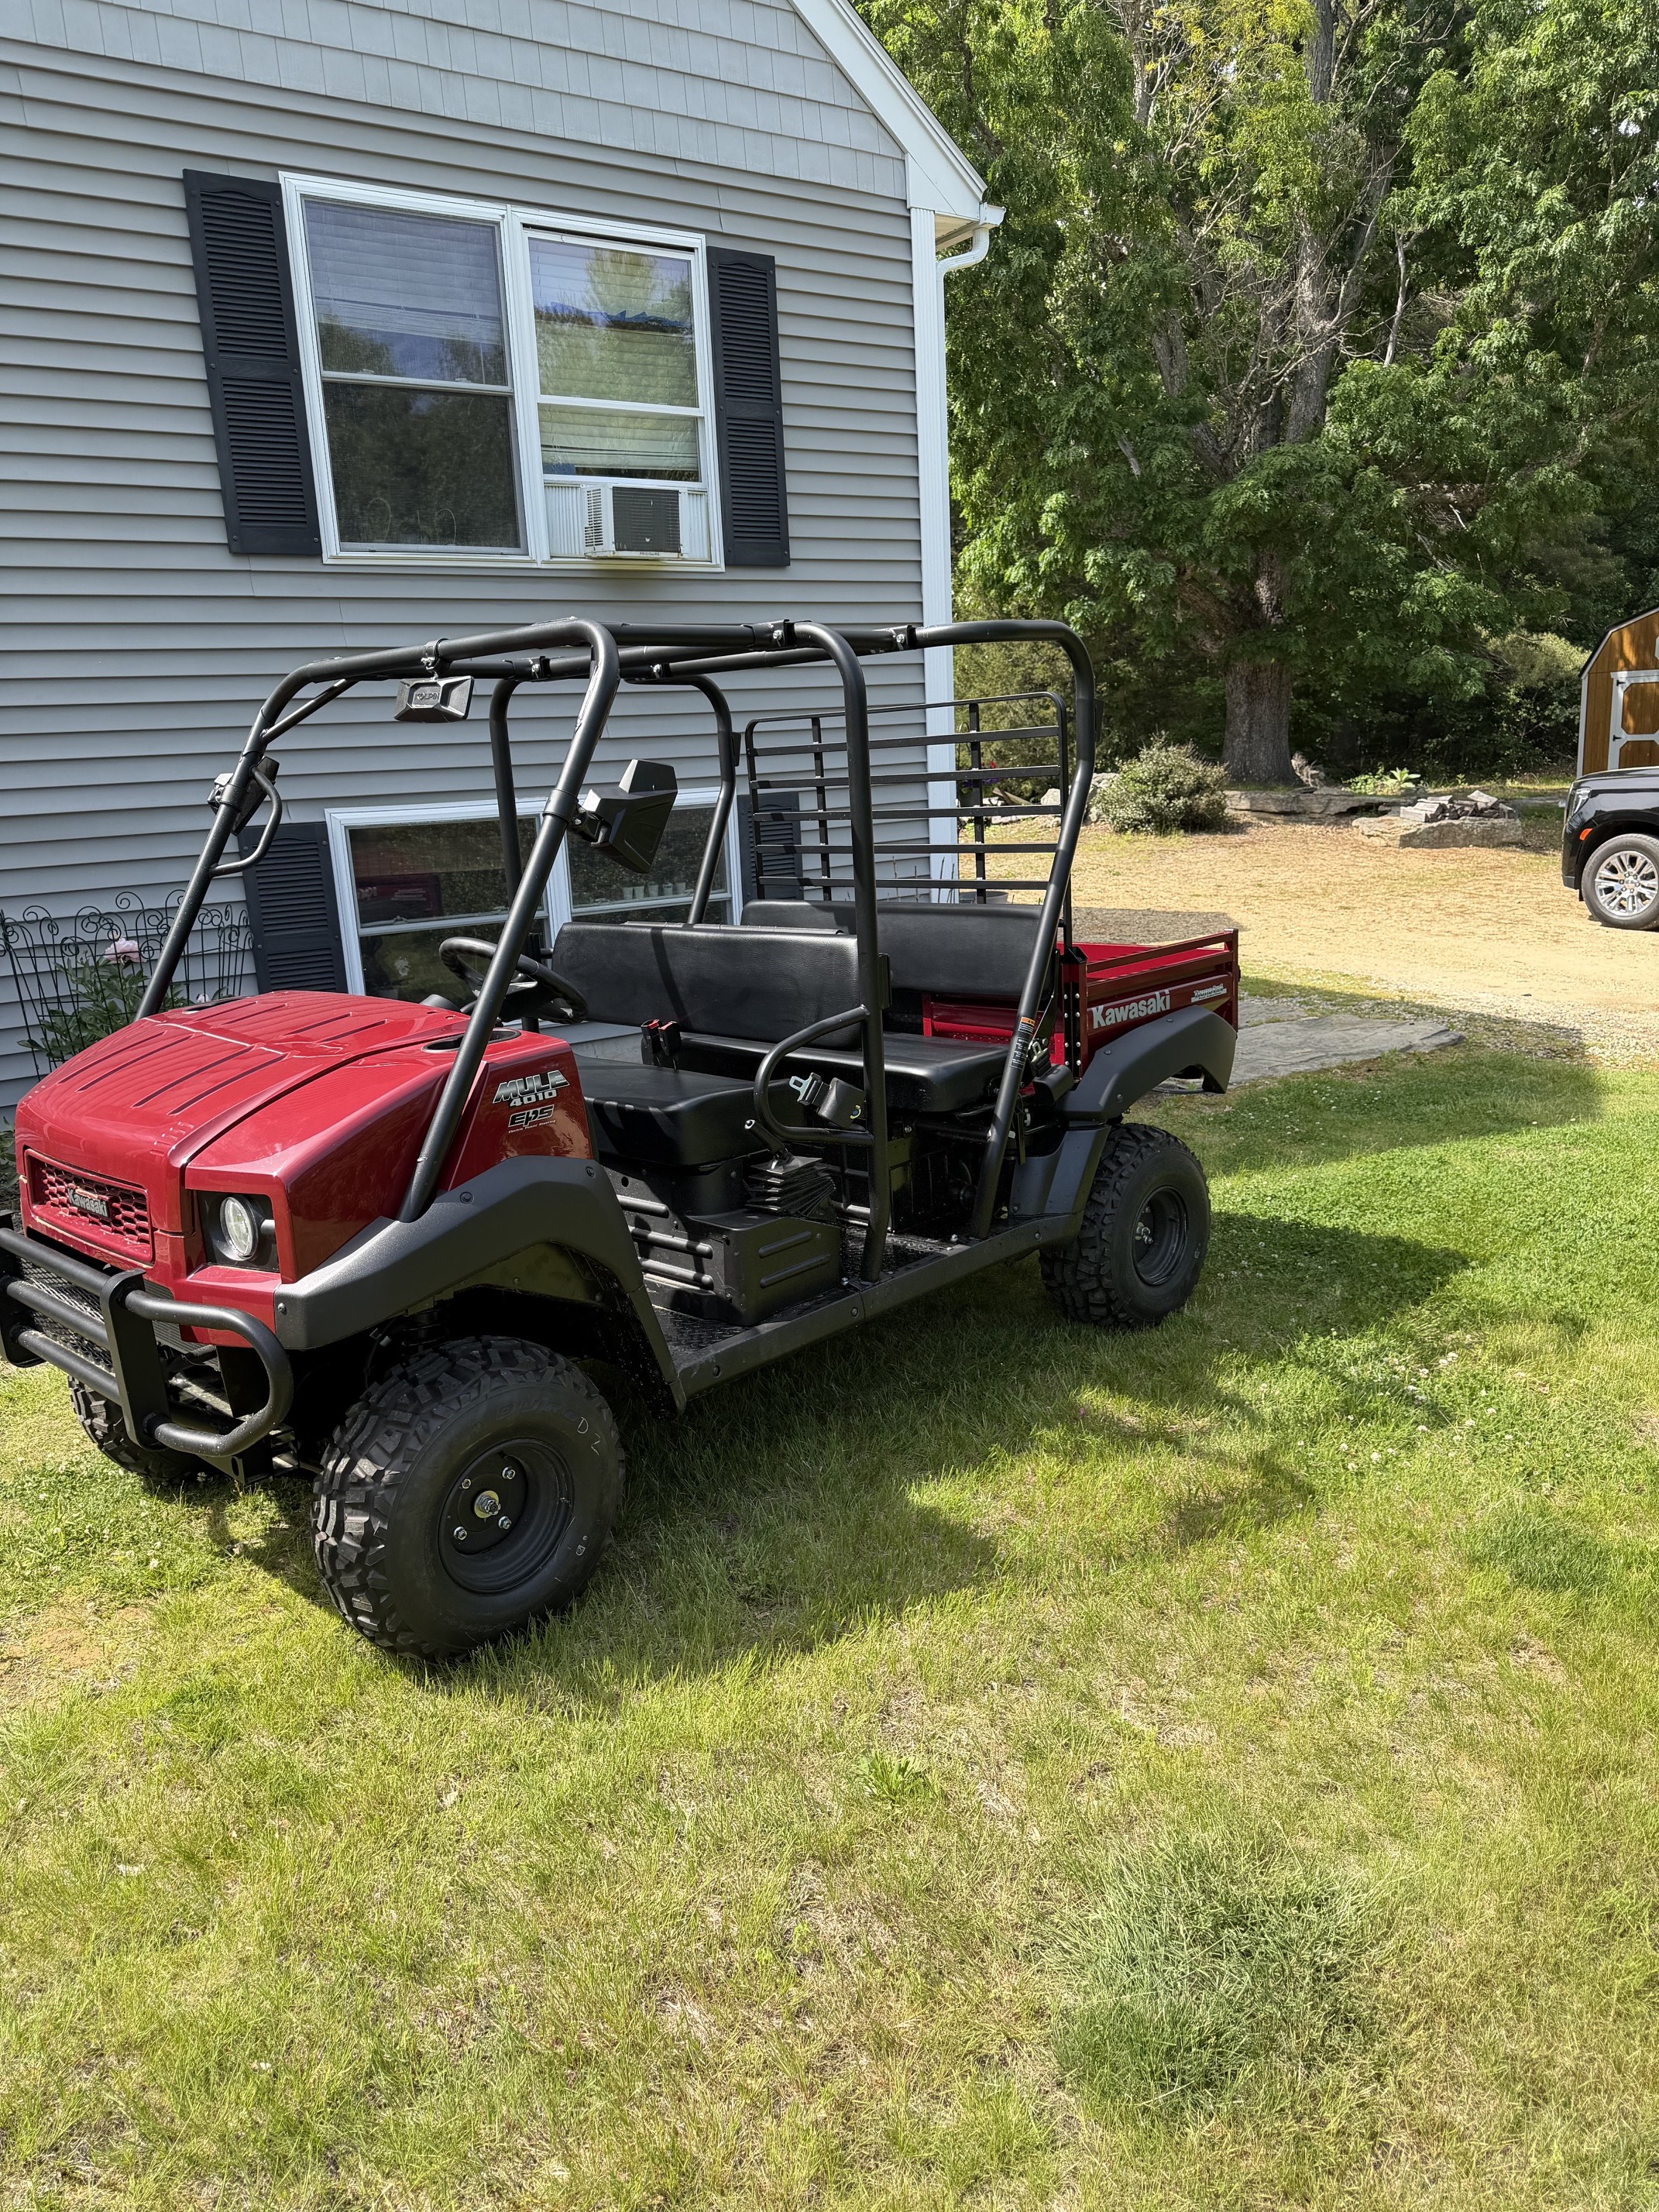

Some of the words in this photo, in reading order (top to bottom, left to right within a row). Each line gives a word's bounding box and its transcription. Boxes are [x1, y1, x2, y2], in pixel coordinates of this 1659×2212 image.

[1091, 990, 1171, 1029] Kawasaki
[493, 1070, 570, 1104] MULE
[510, 1089, 557, 1107] 4010
[508, 1104, 555, 1128] EPS
[67, 1188, 108, 1218] Kawasaki
